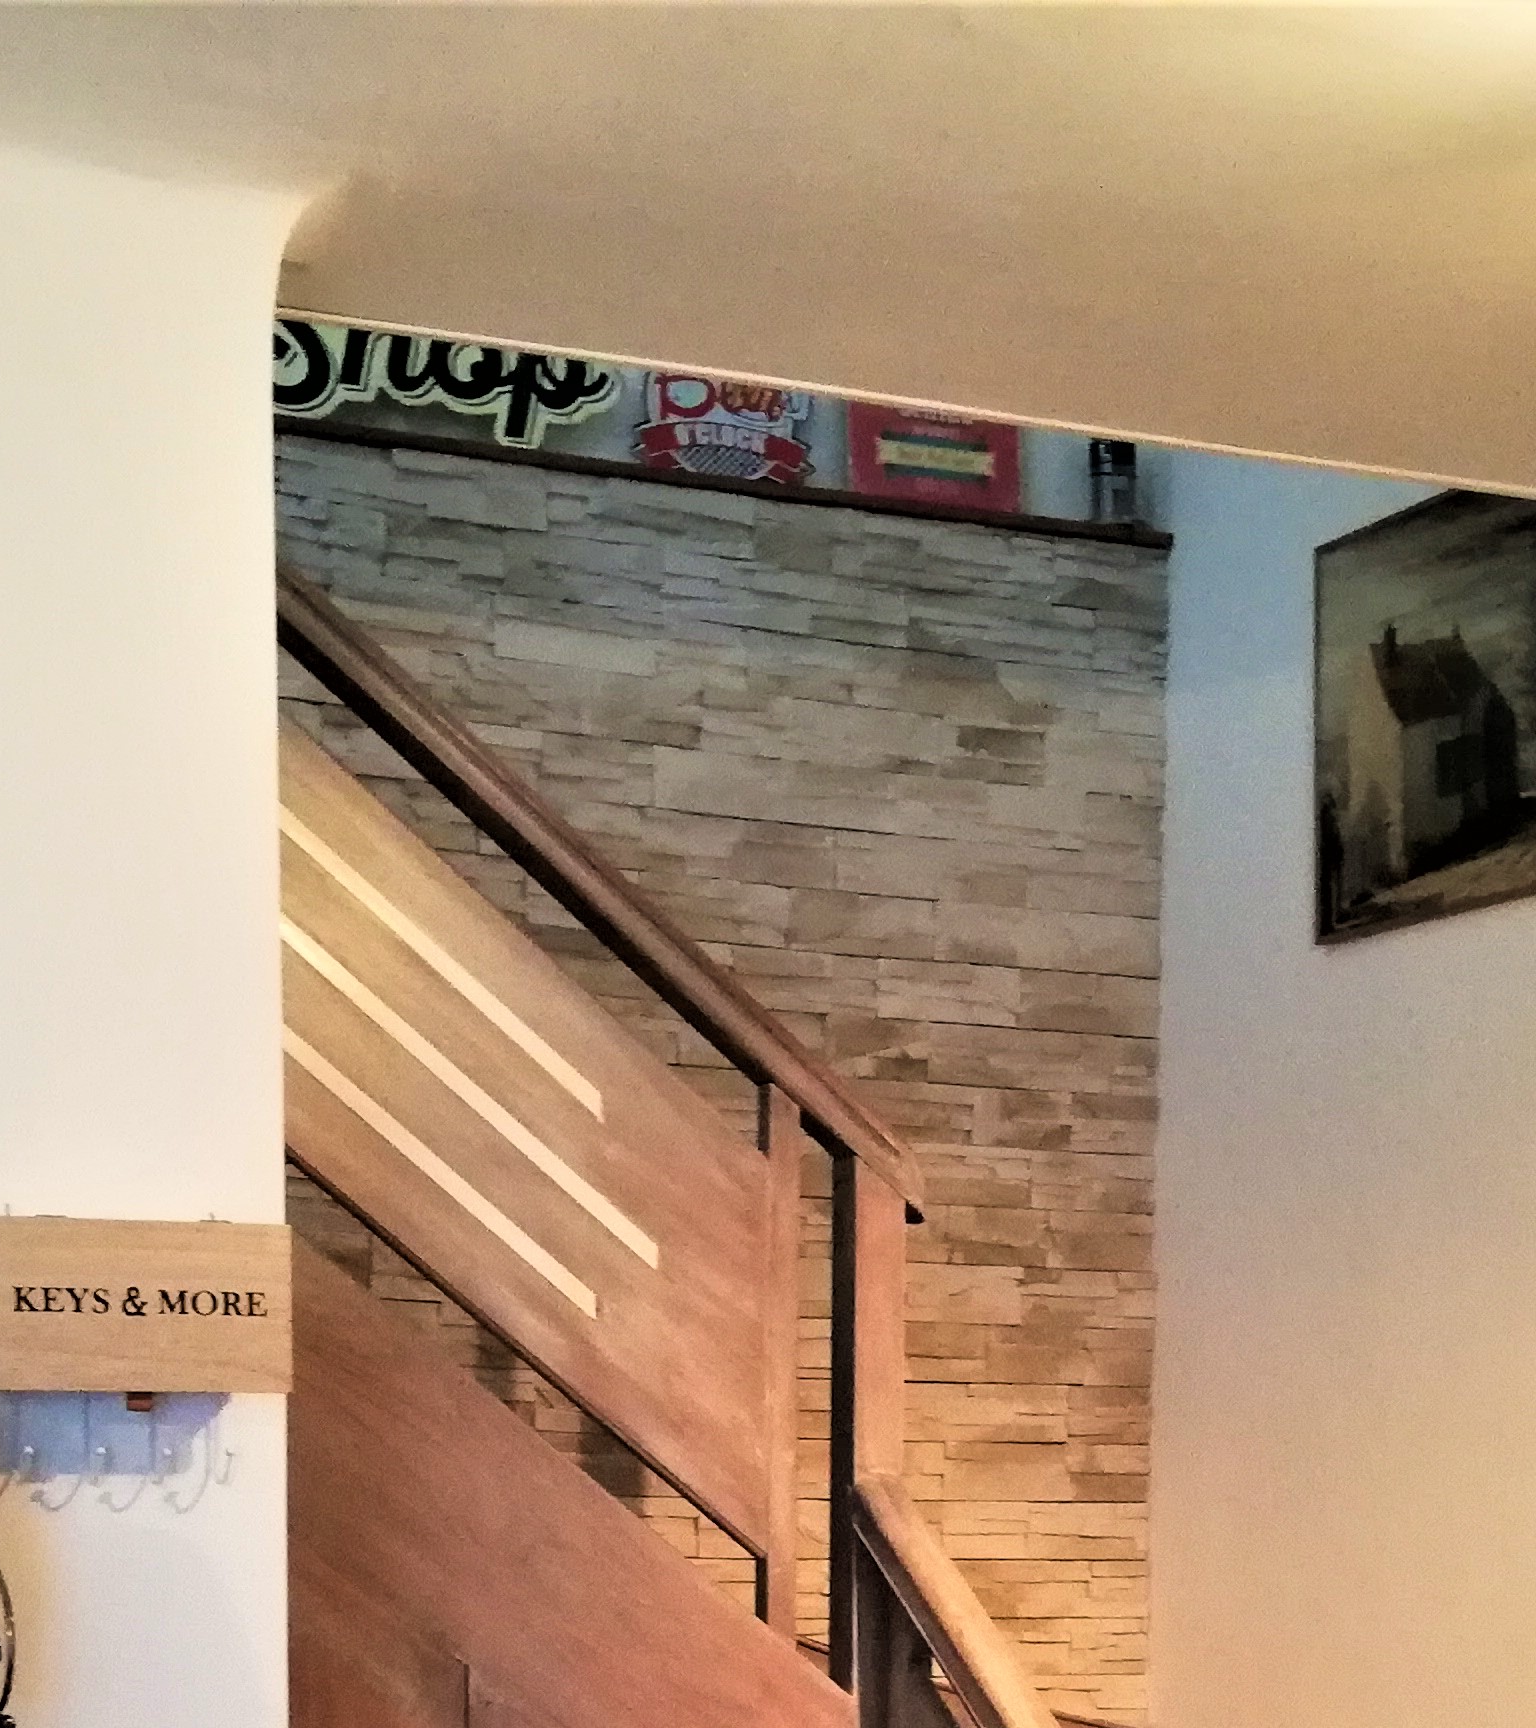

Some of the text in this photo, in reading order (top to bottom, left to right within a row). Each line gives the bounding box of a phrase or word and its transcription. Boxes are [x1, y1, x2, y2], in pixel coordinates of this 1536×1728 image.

[13, 1286, 269, 1317] KEYS & MORE
